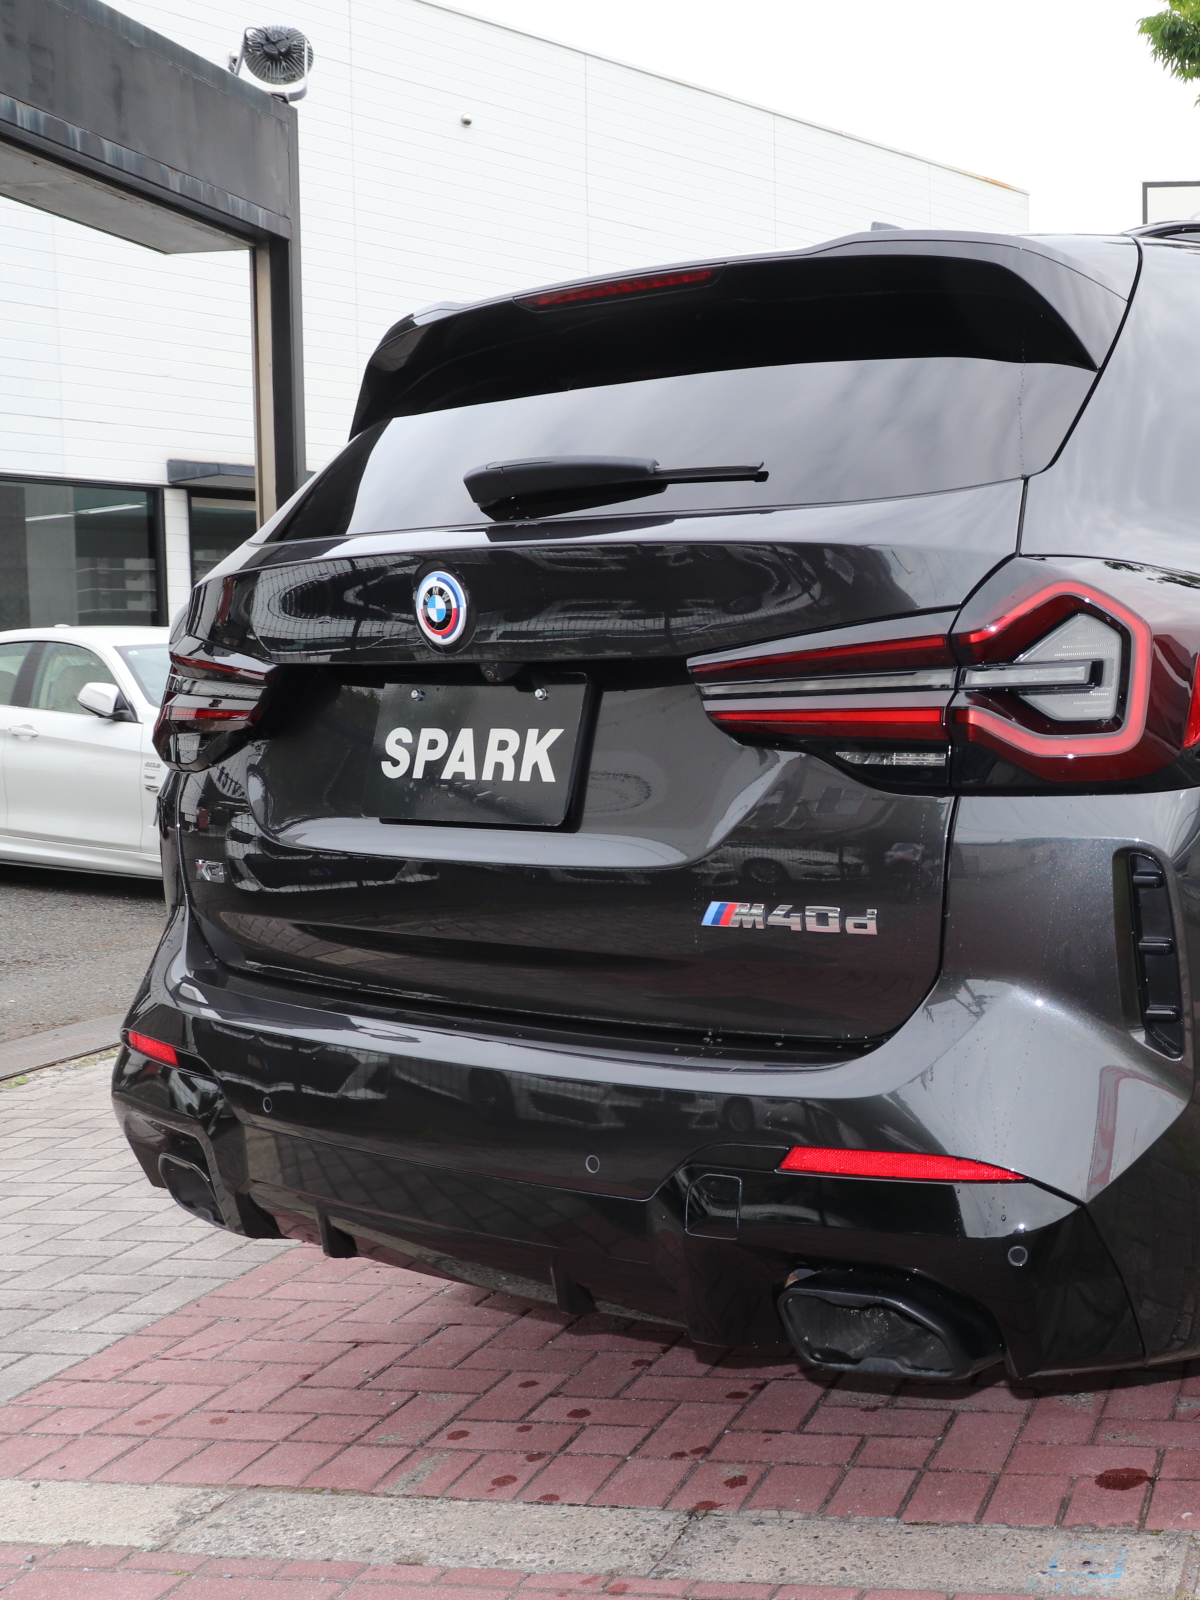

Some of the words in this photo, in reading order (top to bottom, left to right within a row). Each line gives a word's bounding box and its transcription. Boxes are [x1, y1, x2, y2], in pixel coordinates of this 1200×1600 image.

[424, 586, 450, 602] BMW
[381, 727, 565, 782] SPARK
[195, 859, 225, 883] X3
[728, 902, 878, 936] M40d
